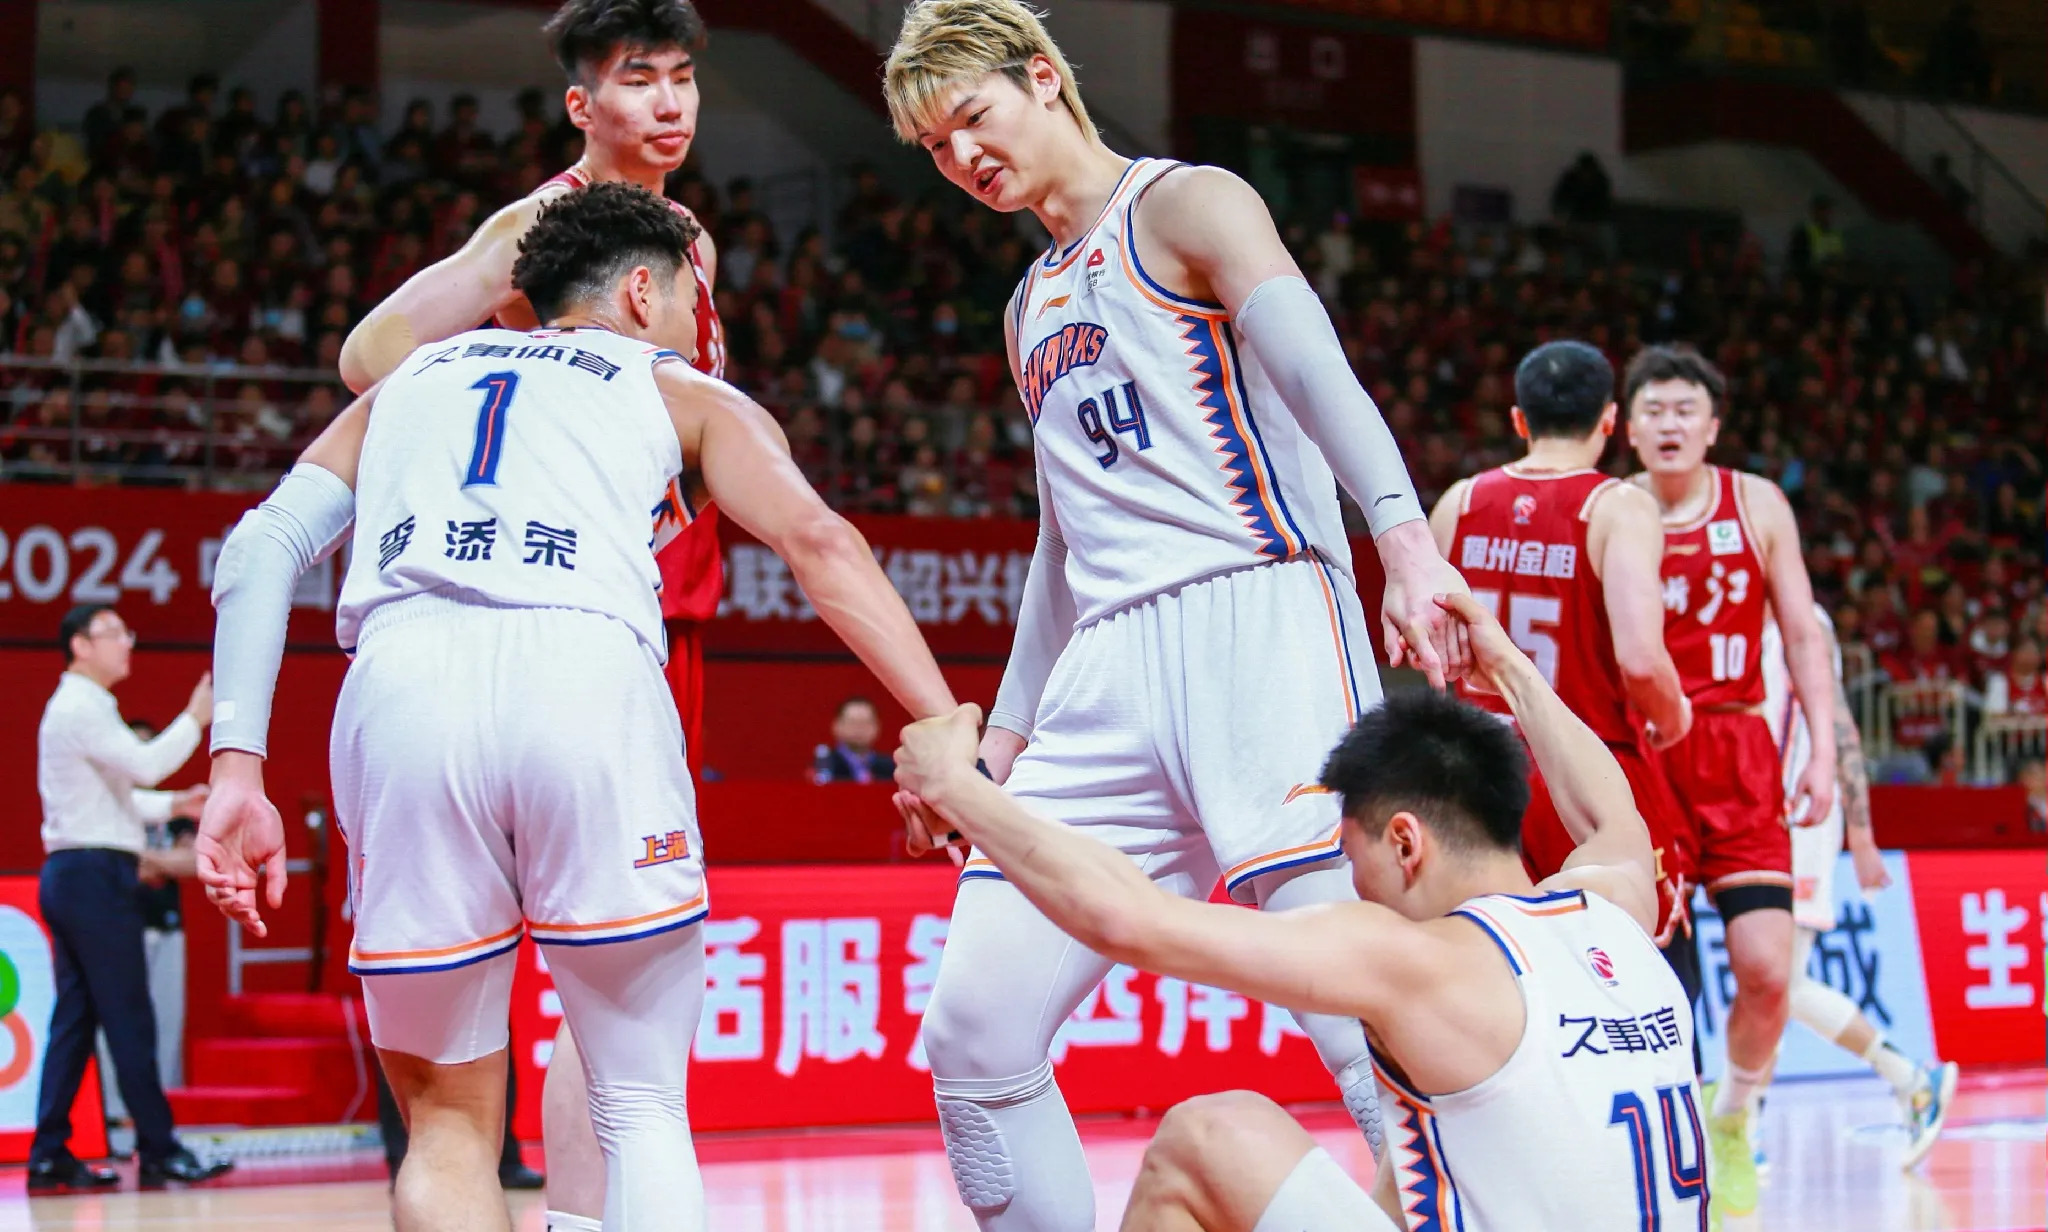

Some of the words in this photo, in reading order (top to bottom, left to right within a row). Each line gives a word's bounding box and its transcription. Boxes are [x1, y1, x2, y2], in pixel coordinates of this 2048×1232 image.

[413, 342, 622, 382] 久事体育
[1023, 322, 1109, 428] HARKS
[462, 369, 520, 490] 1
[1077, 381, 1153, 469] 94
[0, 524, 179, 605] 024
[1709, 632, 1748, 681] 10
[634, 830, 690, 868] 上海
[1961, 888, 2048, 1018] 生
[1608, 1082, 1710, 1232] 14
